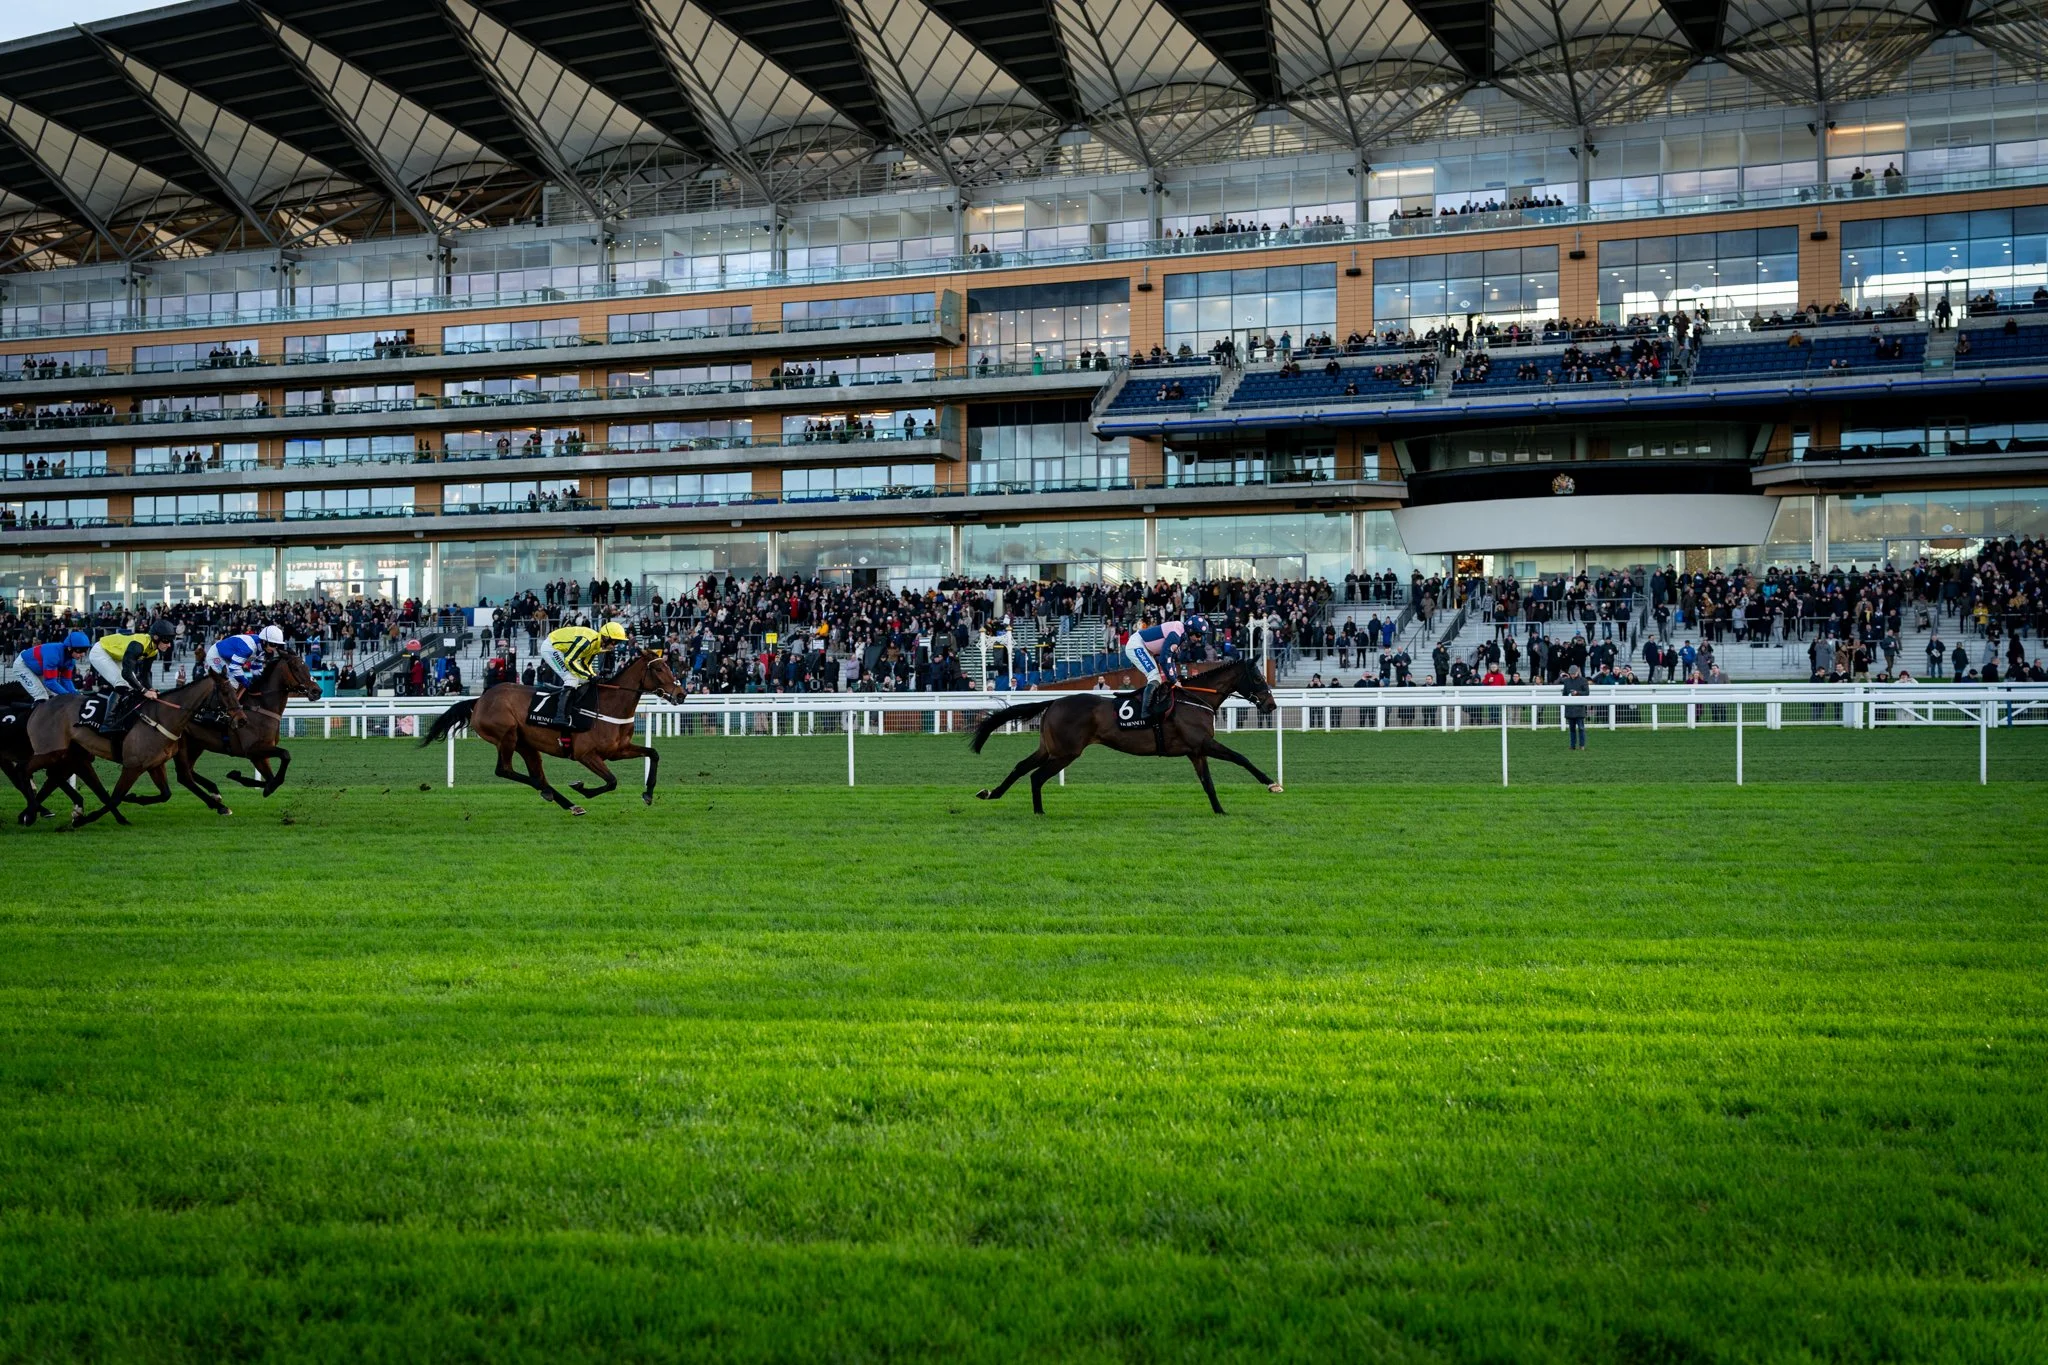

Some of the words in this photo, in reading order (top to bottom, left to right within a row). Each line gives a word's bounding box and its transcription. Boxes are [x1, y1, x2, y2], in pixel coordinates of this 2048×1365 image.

[552, 651, 568, 673] UNIBET
[1136, 648, 1151, 668] CORAL
[81, 699, 100, 720] 5
[533, 691, 552, 713] 7
[1118, 699, 1134, 720] 6
